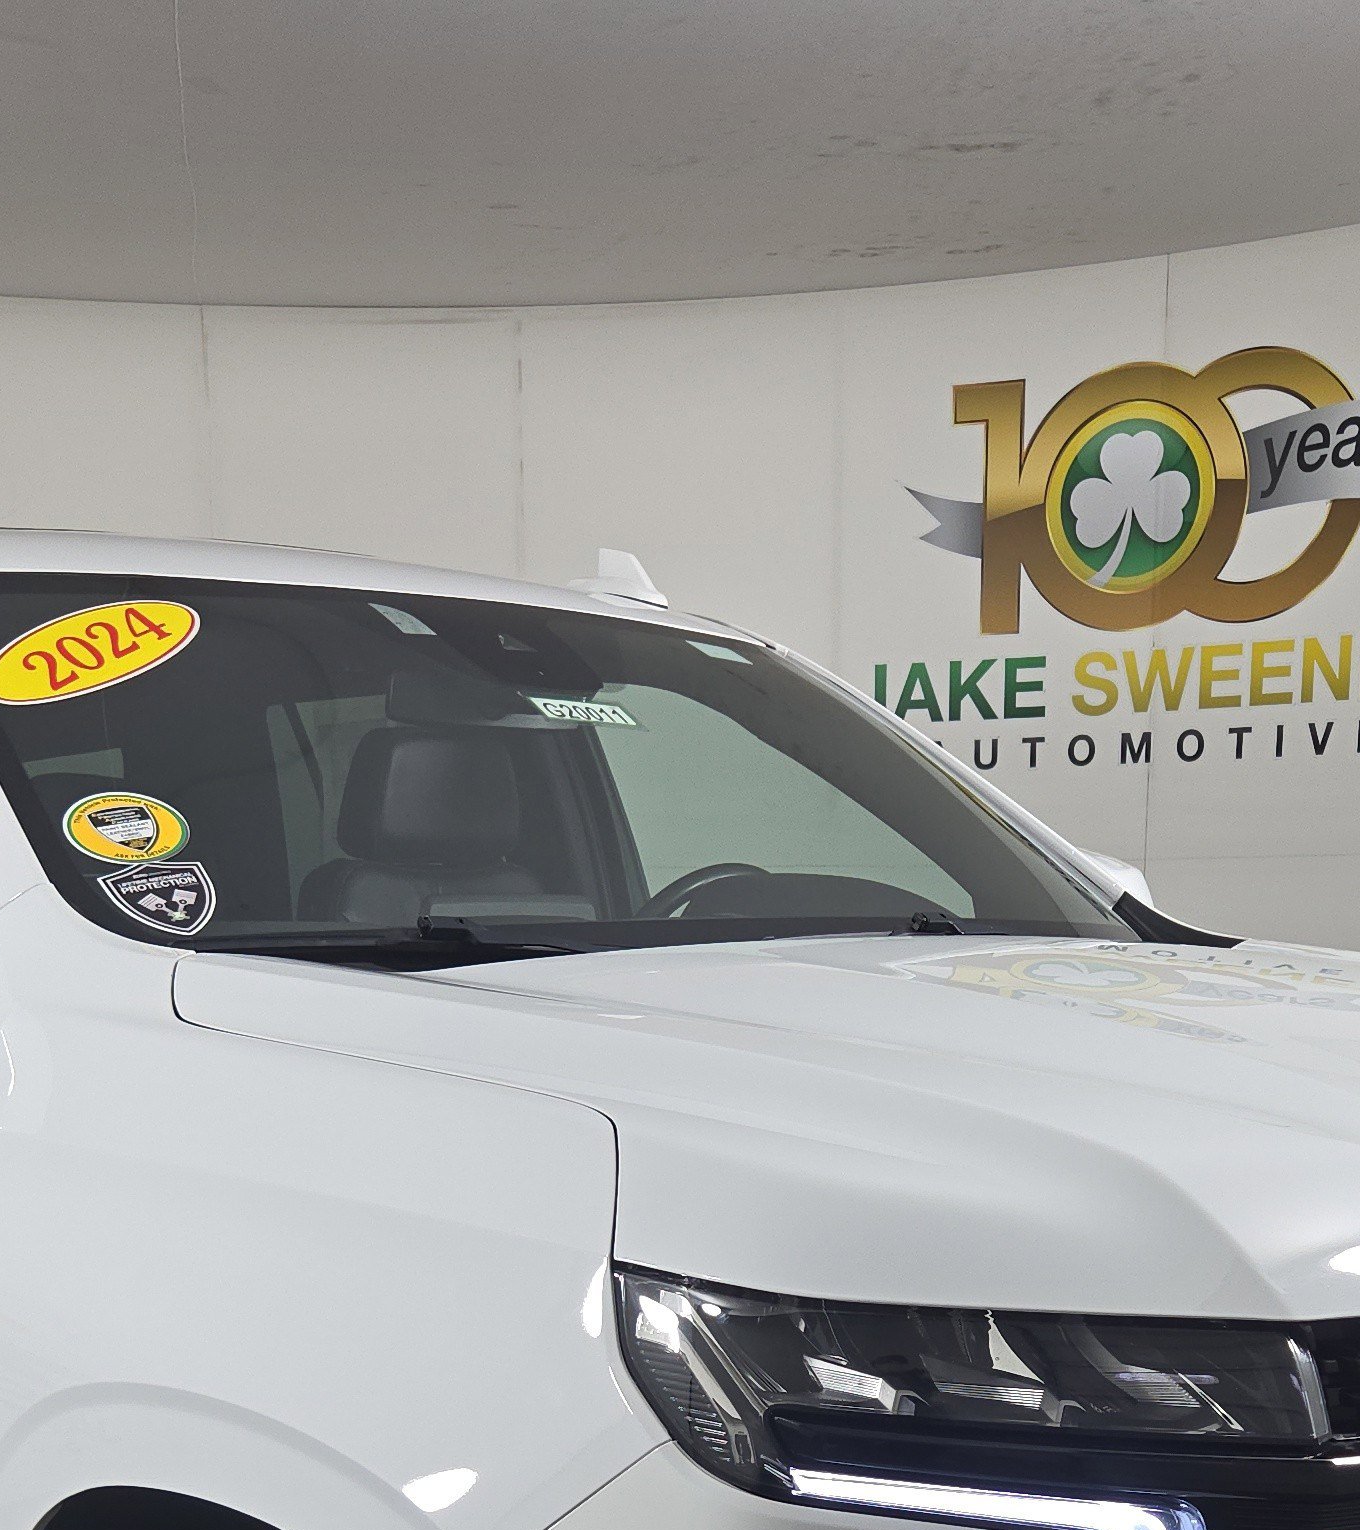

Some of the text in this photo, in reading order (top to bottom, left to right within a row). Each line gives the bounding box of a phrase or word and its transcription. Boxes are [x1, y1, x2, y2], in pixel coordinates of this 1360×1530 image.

[22, 606, 173, 692] 2024
[542, 702, 629, 724] G20011
[119, 875, 198, 895] PROTECTION
